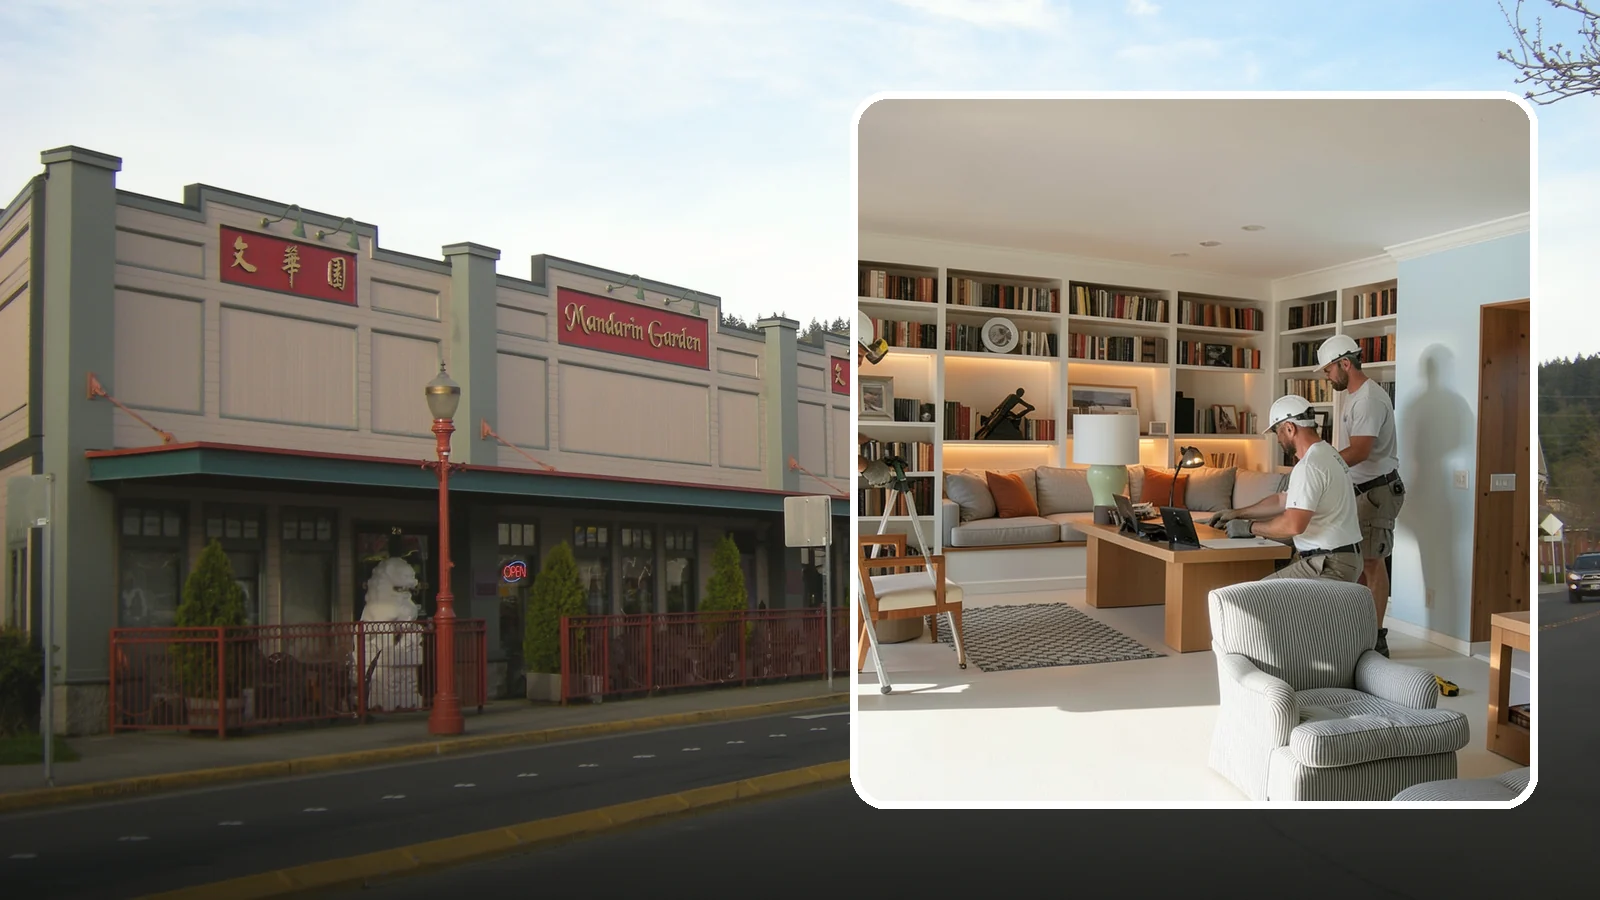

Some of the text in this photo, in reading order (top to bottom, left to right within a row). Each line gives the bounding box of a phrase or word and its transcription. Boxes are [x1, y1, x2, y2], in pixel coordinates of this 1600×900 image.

[231, 235, 346, 291] 文華園
[564, 302, 702, 352] Mandarin Garden
[834, 362, 846, 386] 文
[503, 565, 527, 578] OPEN
